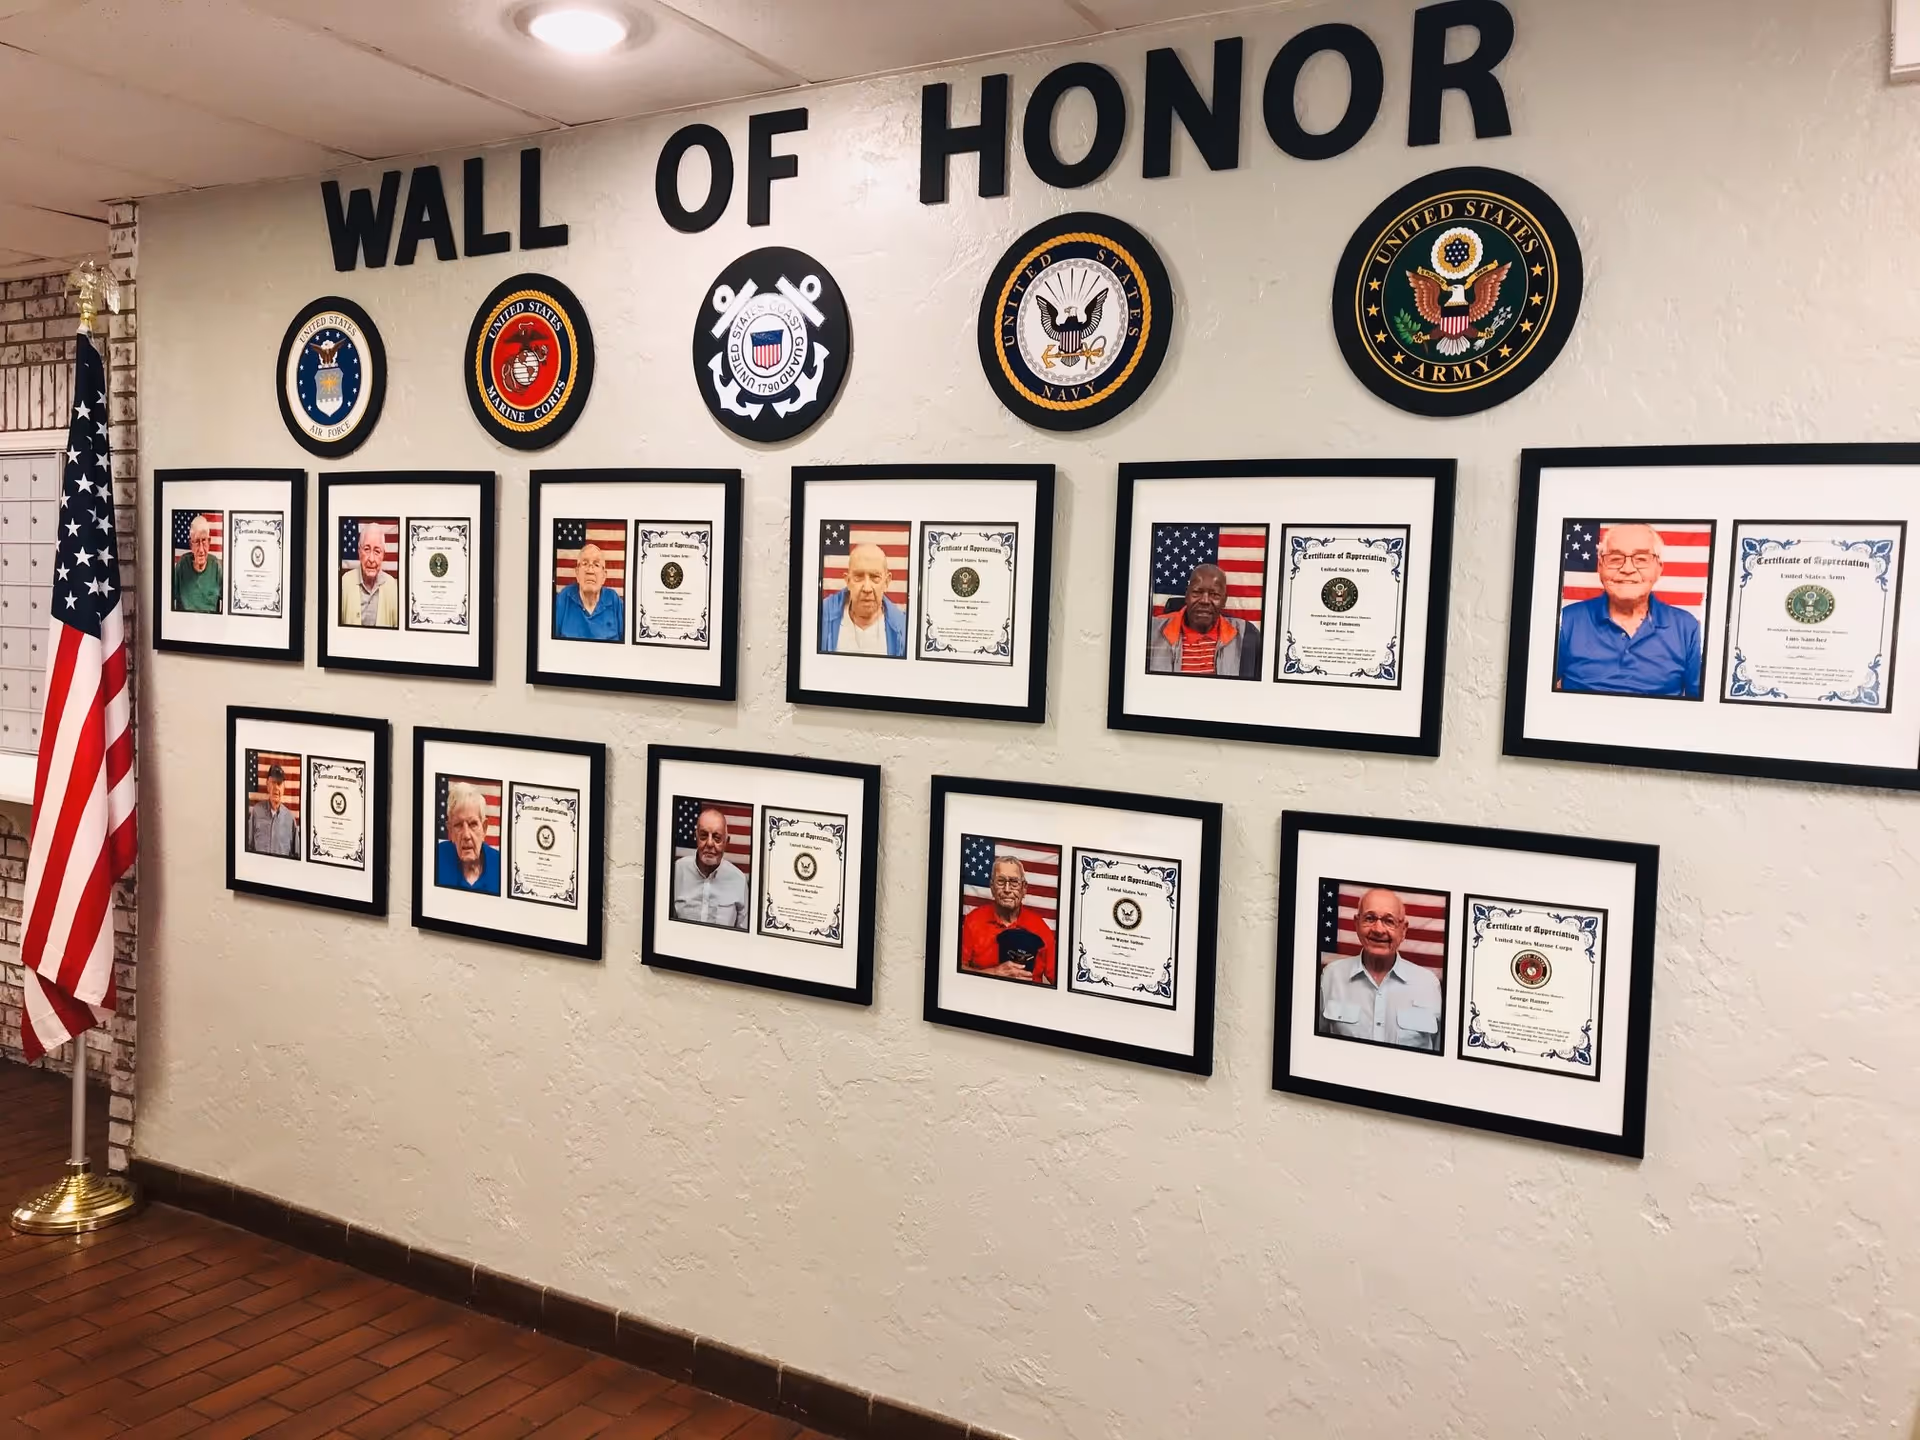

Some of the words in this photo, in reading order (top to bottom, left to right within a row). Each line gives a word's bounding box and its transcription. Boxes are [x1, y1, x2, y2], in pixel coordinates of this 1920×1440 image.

[321, 148, 568, 271] WALL
[656, 107, 808, 234] OF
[920, 0, 1515, 205] HONOR
[1375, 202, 1454, 265] UNITED
[1464, 200, 1539, 253] STATES
[1004, 254, 1051, 347] UNITED
[1096, 249, 1140, 337] STATES
[299, 318, 326, 343] UNITED
[329, 316, 357, 337] STATES
[488, 302, 524, 339] UNITED
[528, 301, 562, 331] STATES
[732, 305, 765, 339] STATES
[769, 301, 802, 331] COAST
[731, 344, 755, 388] UNITED
[780, 336, 804, 384] GUARD
[1411, 355, 1491, 382] ARMY
[758, 381, 779, 393] 1790
[1043, 382, 1096, 400] NAVY
[486, 384, 525, 422] MARINE
[534, 380, 565, 419] CORPS
[310, 425, 323, 437] AIR
[328, 420, 351, 437] FORCE
[1303, 552, 1336, 560] Certificate
[1345, 552, 1387, 563] Appreciation
[1756, 556, 1801, 565] Certificate
[1803, 556, 1812, 565] of
[1813, 556, 1870, 569] Appreciation
[1091, 871, 1120, 881] Certificate
[1127, 875, 1163, 889] Appreciation
[1485, 922, 1523, 932] Certificate
[1524, 925, 1532, 933] of
[1533, 926, 1580, 941] Appreciation
[1514, 938, 1532, 946] States
[1533, 941, 1554, 949] Marine
[1555, 944, 1573, 952] Corps
